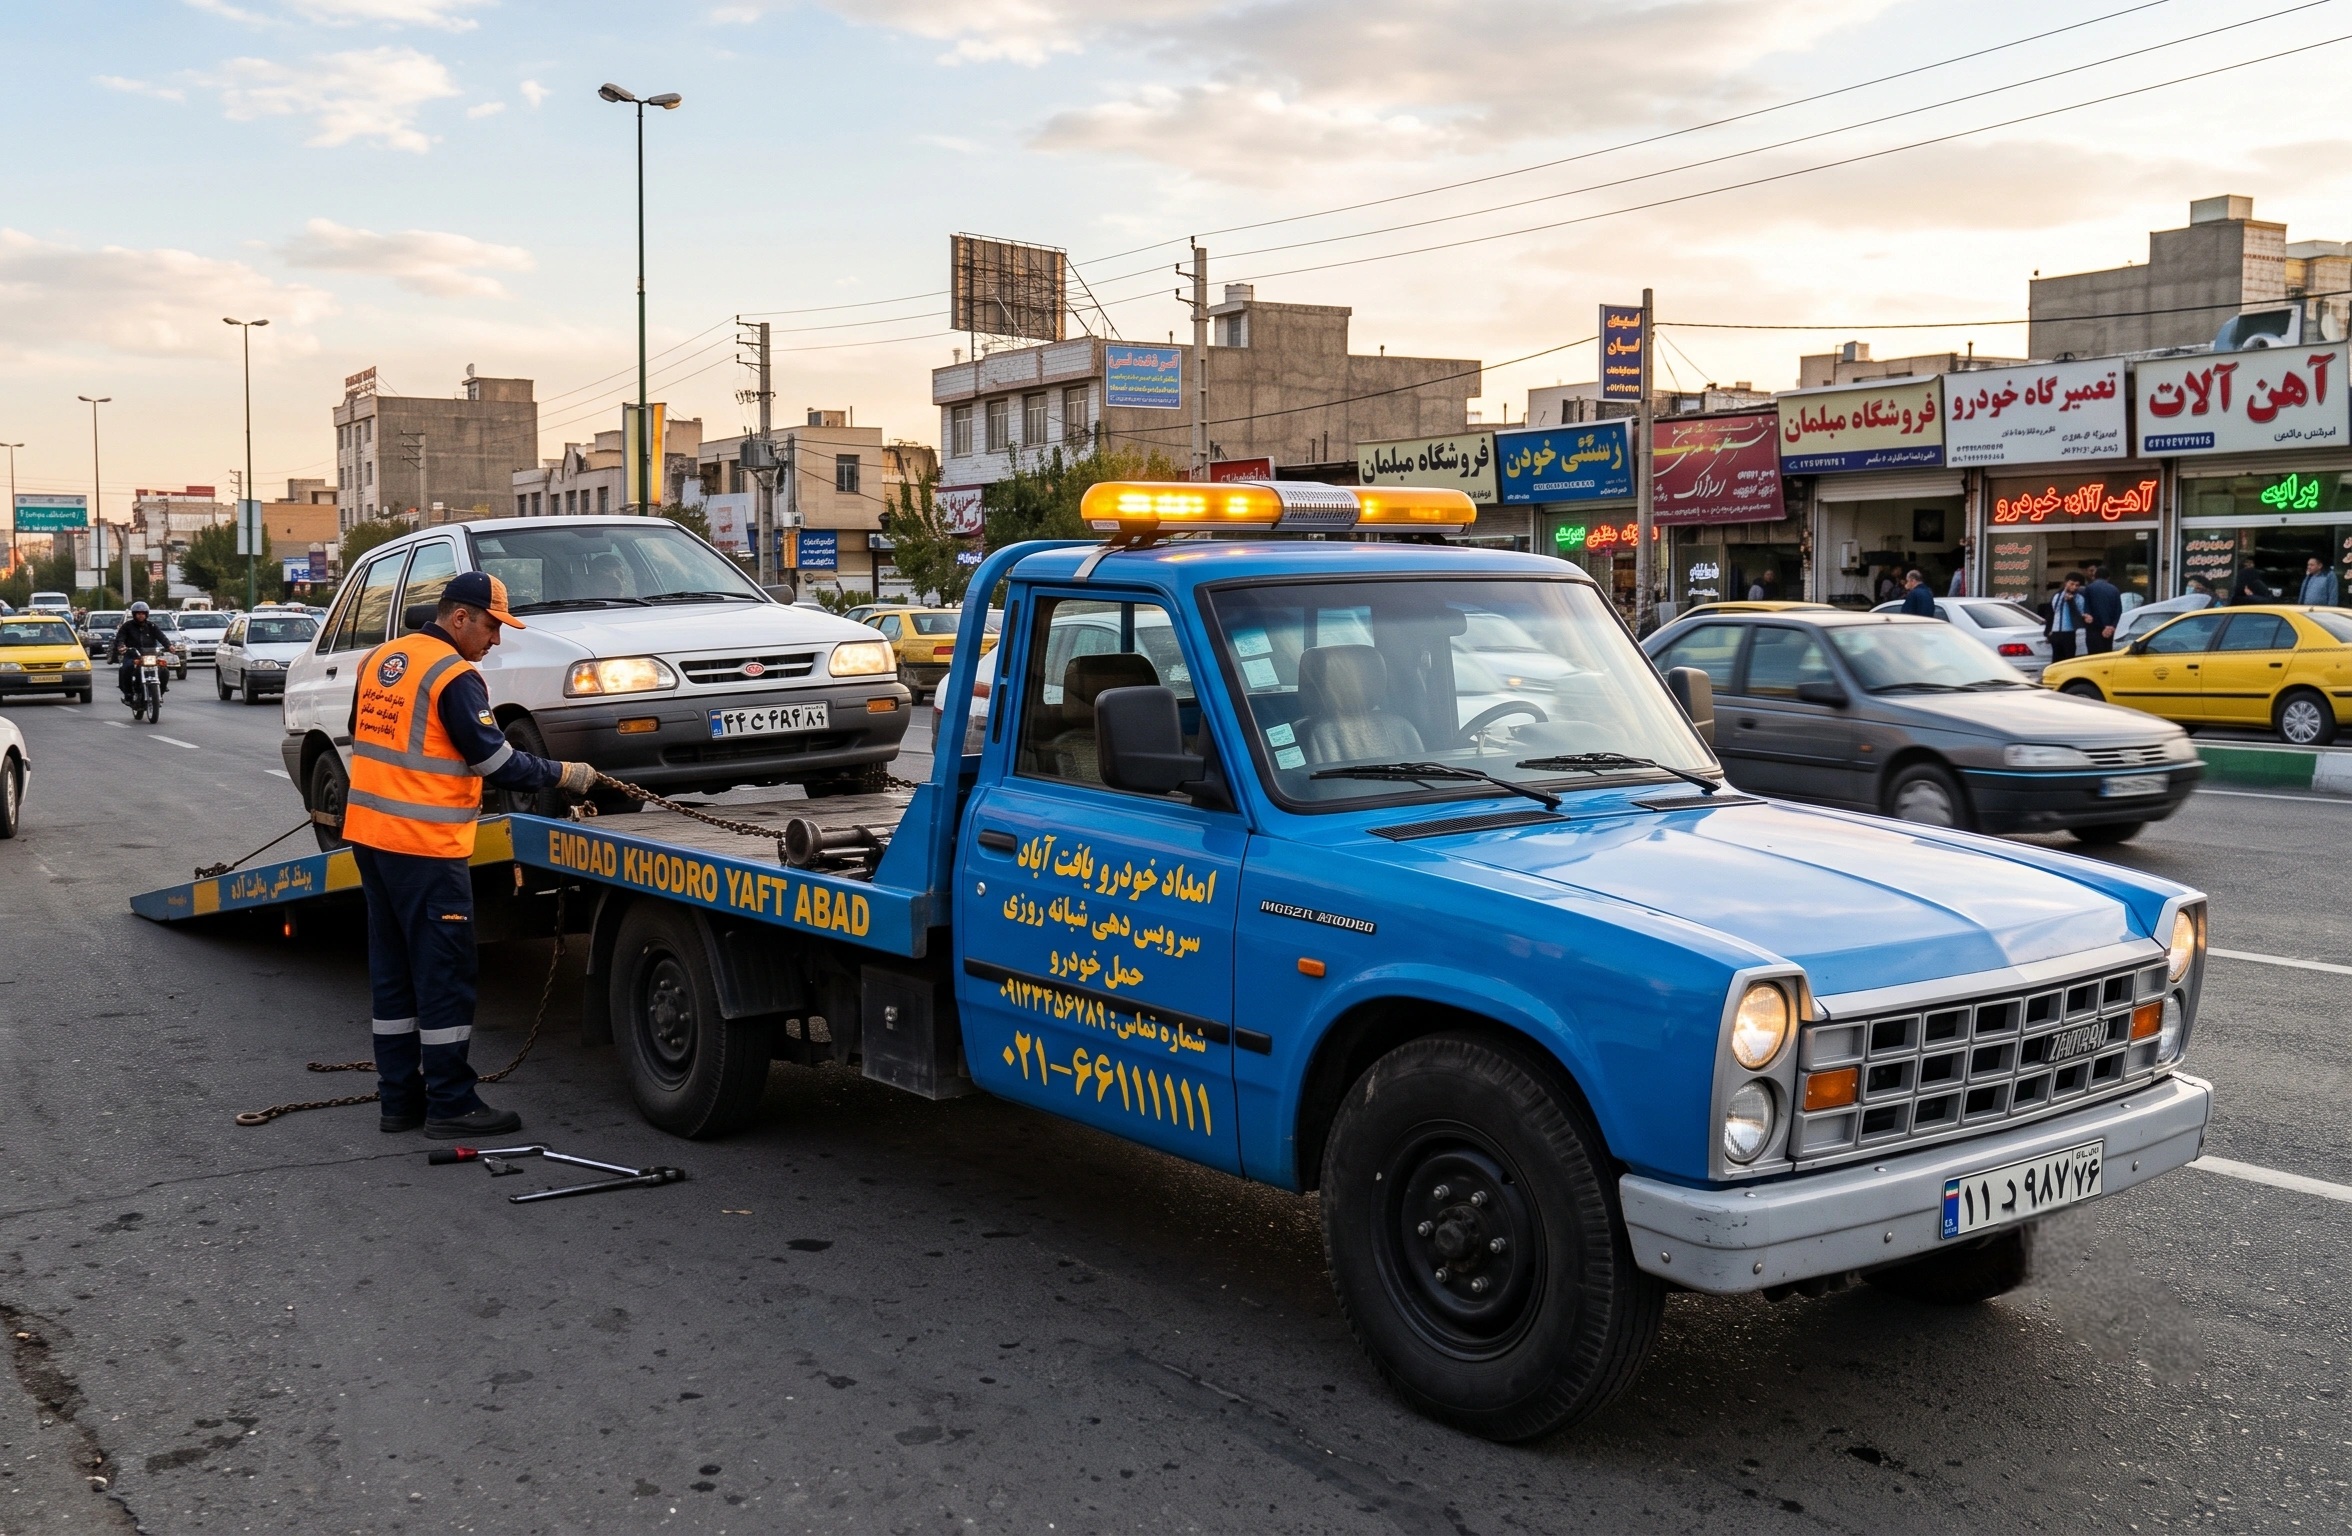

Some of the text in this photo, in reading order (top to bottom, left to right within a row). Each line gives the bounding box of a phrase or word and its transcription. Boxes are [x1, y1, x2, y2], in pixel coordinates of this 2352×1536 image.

[1952, 379, 2019, 421] خودرو
[2149, 352, 2336, 424] آهن آلات
[1784, 392, 1936, 443] فروشگاه مبلمان
[1362, 437, 1489, 484] فروشگاه مبلمان
[549, 829, 870, 937] EMDAD KHODRO YAFT ABAD
[1017, 834, 1217, 904] امداد خودرو یافت آباد
[1003, 892, 1201, 959] سرویس دهی شبانه روزی
[1049, 949, 1144, 990] حمل خودرو
[1000, 977, 1106, 1030] ۰۹۱۲۳۴۵۶۷۸۹
[1160, 1022, 1206, 1053] شماره
